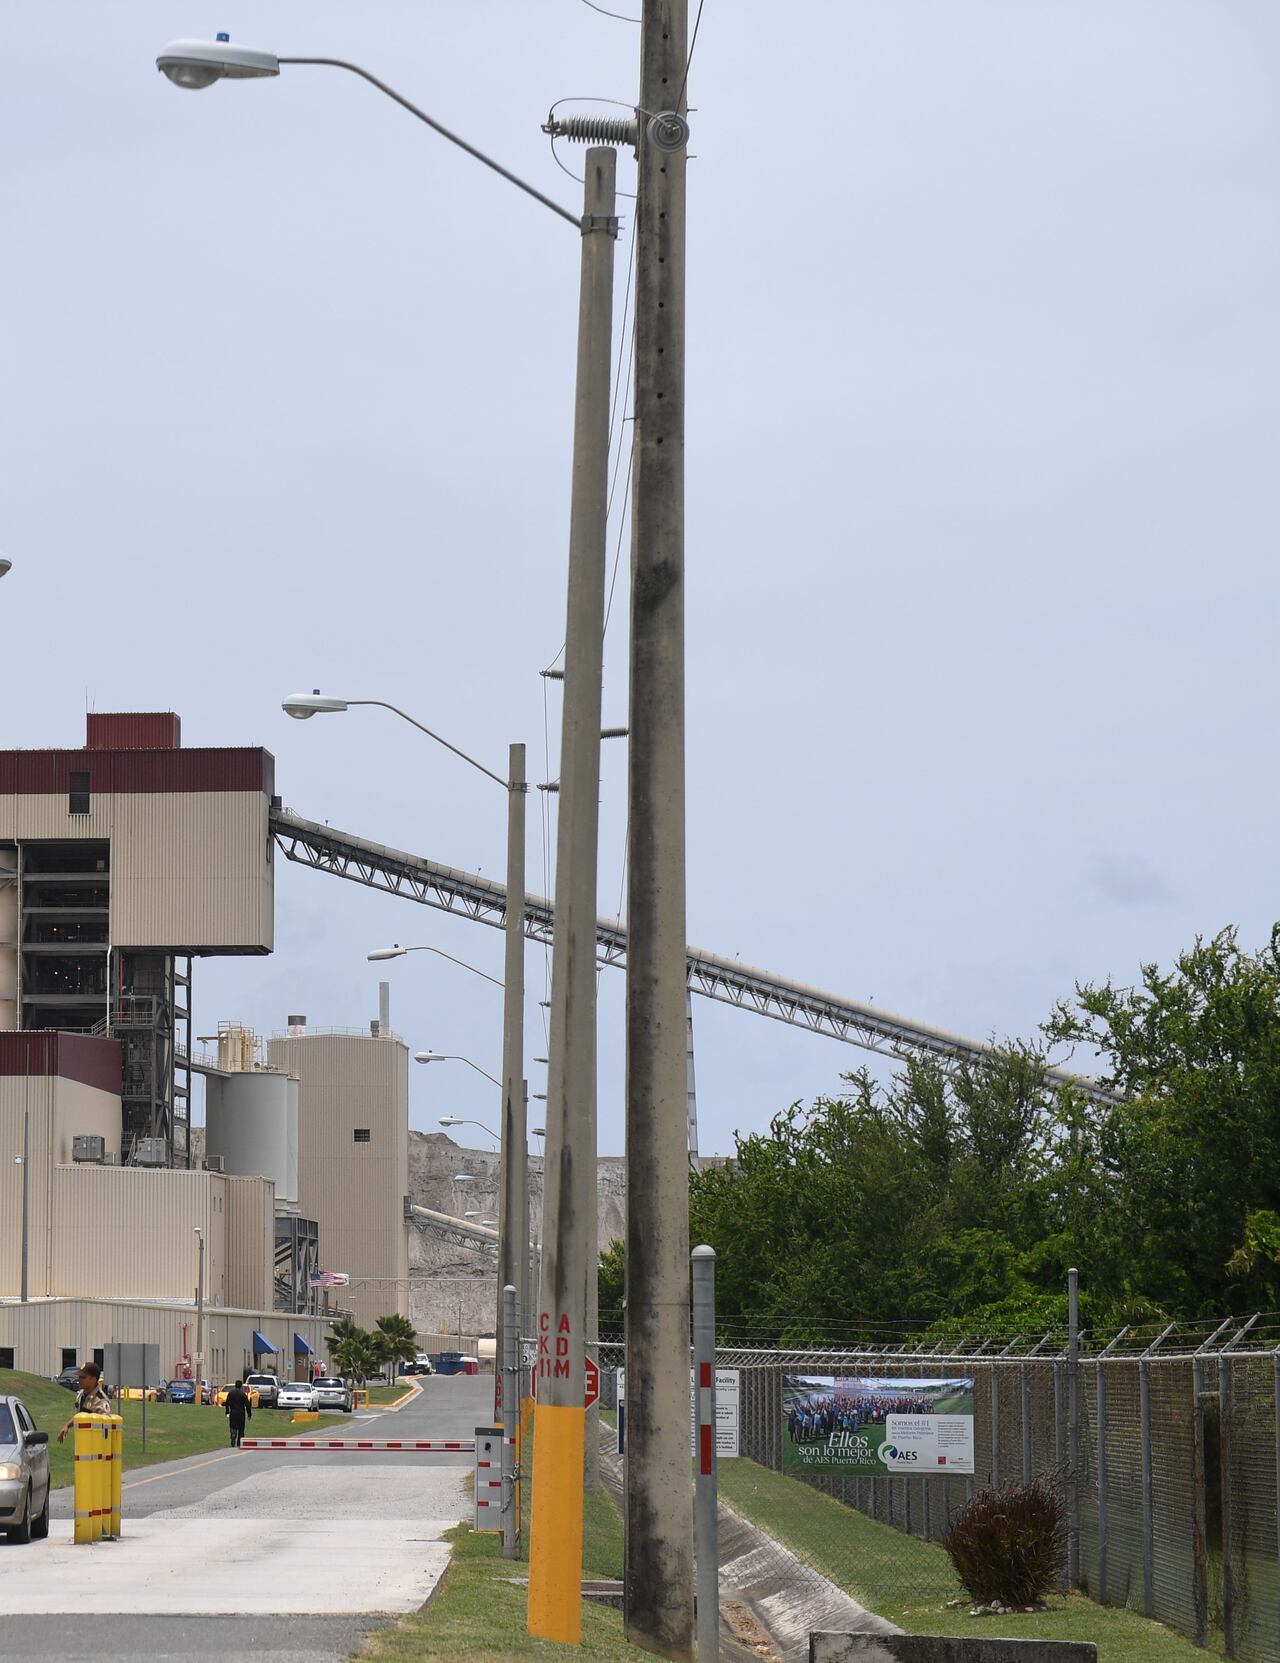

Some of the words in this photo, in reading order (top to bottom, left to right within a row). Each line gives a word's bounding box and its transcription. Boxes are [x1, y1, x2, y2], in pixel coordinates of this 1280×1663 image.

[828, 1431, 869, 1448] Ellos
[798, 1446, 820, 1456] son
[823, 1445, 835, 1456] lo
[837, 1447, 874, 1460] mejor
[898, 1451, 918, 1461] AES
[803, 1456, 813, 1464] de
